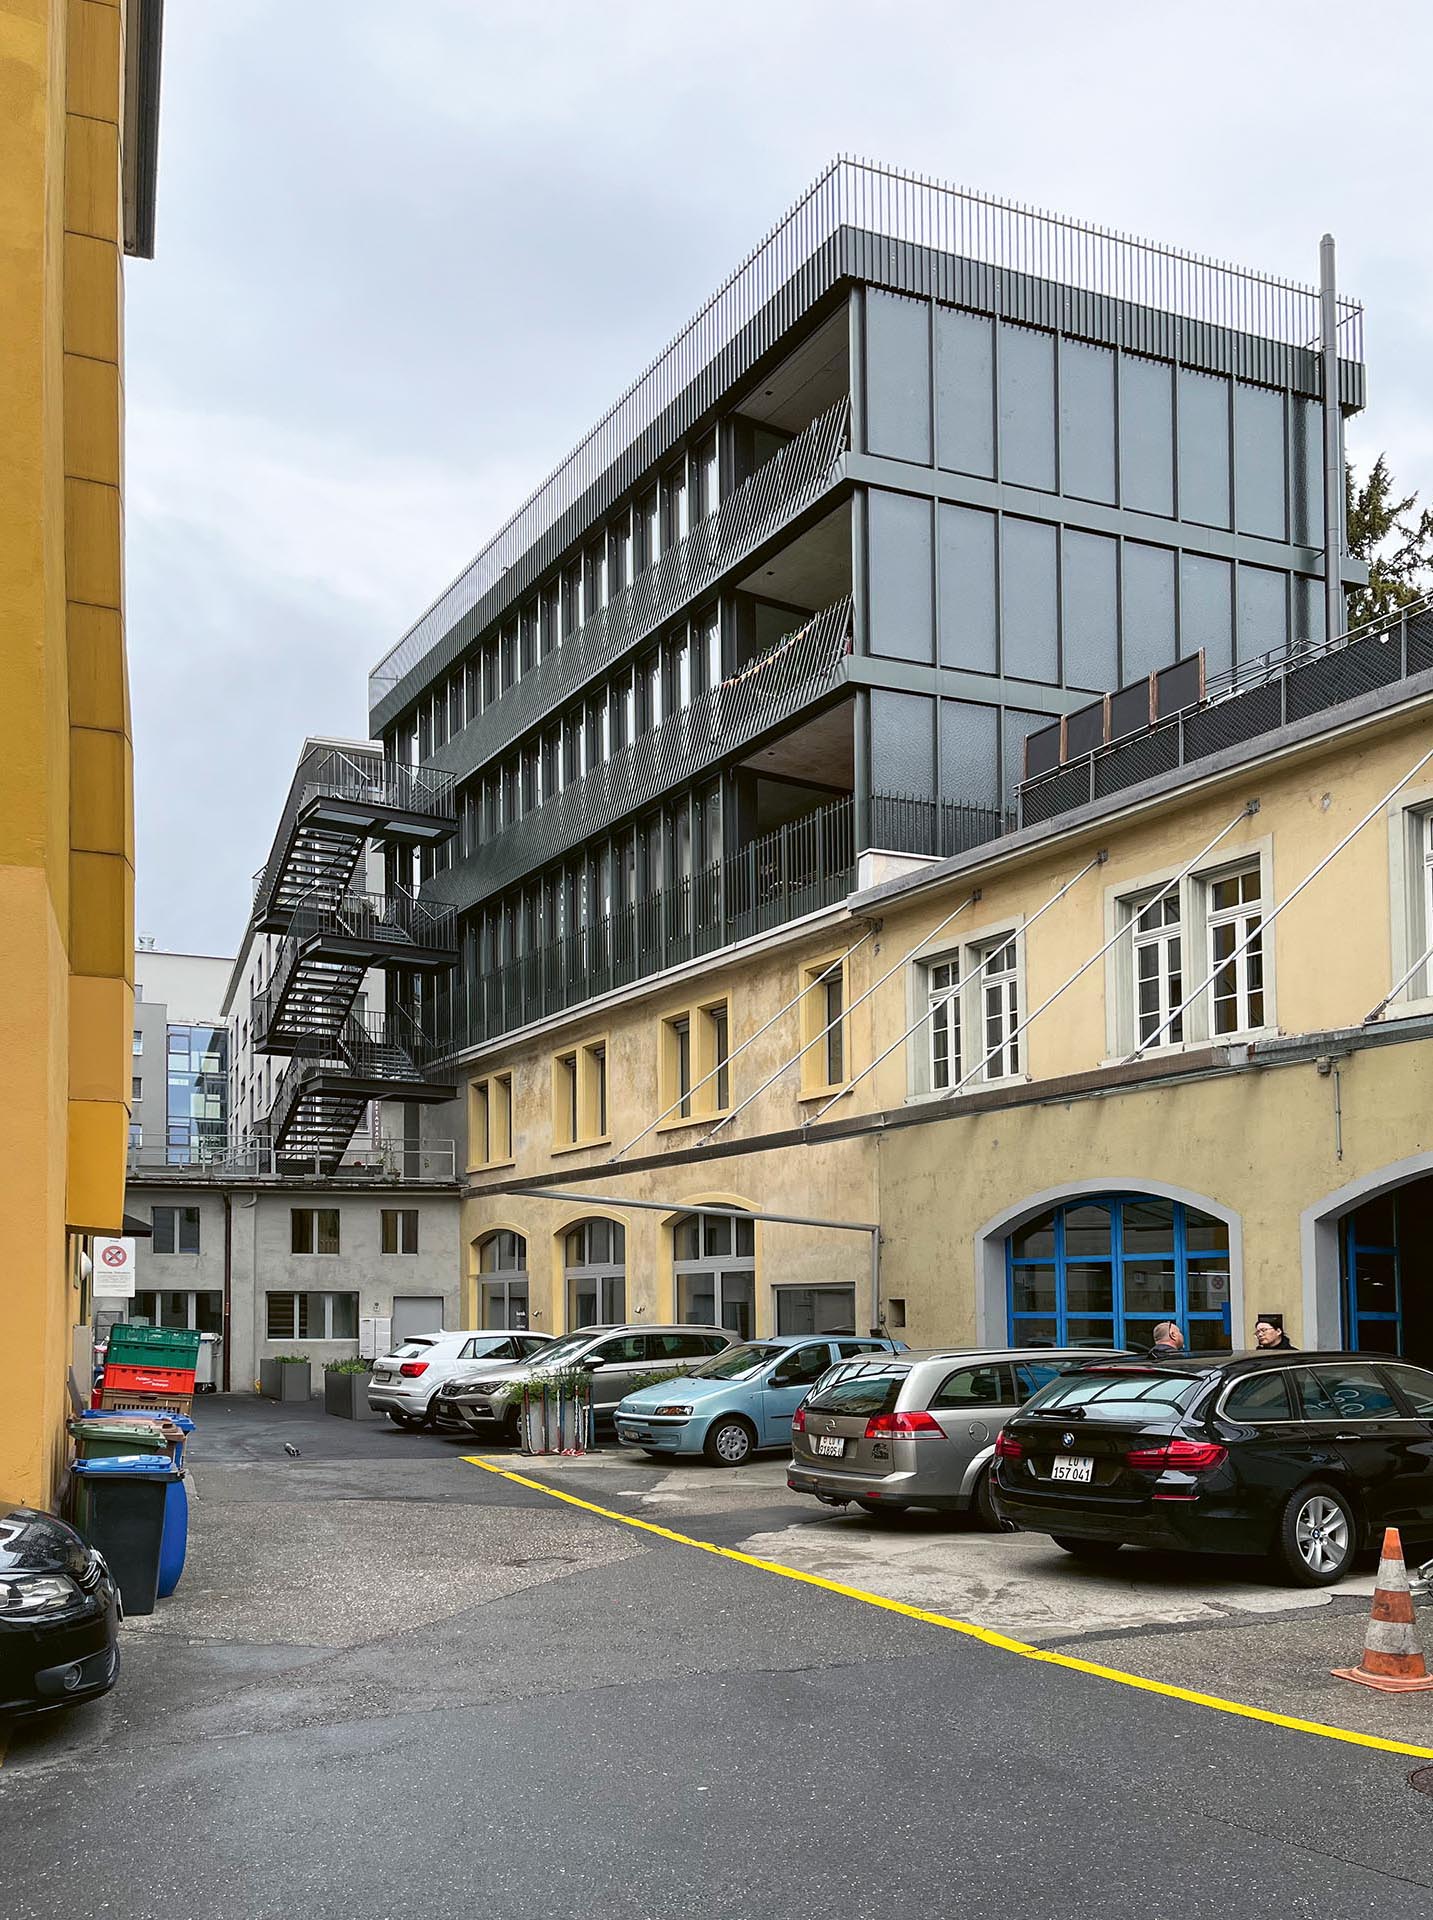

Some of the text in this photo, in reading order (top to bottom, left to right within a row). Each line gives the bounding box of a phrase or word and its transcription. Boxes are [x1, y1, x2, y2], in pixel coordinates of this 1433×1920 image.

[1068, 1456, 1079, 1466] LU
[1054, 1467, 1090, 1481] 157 041
